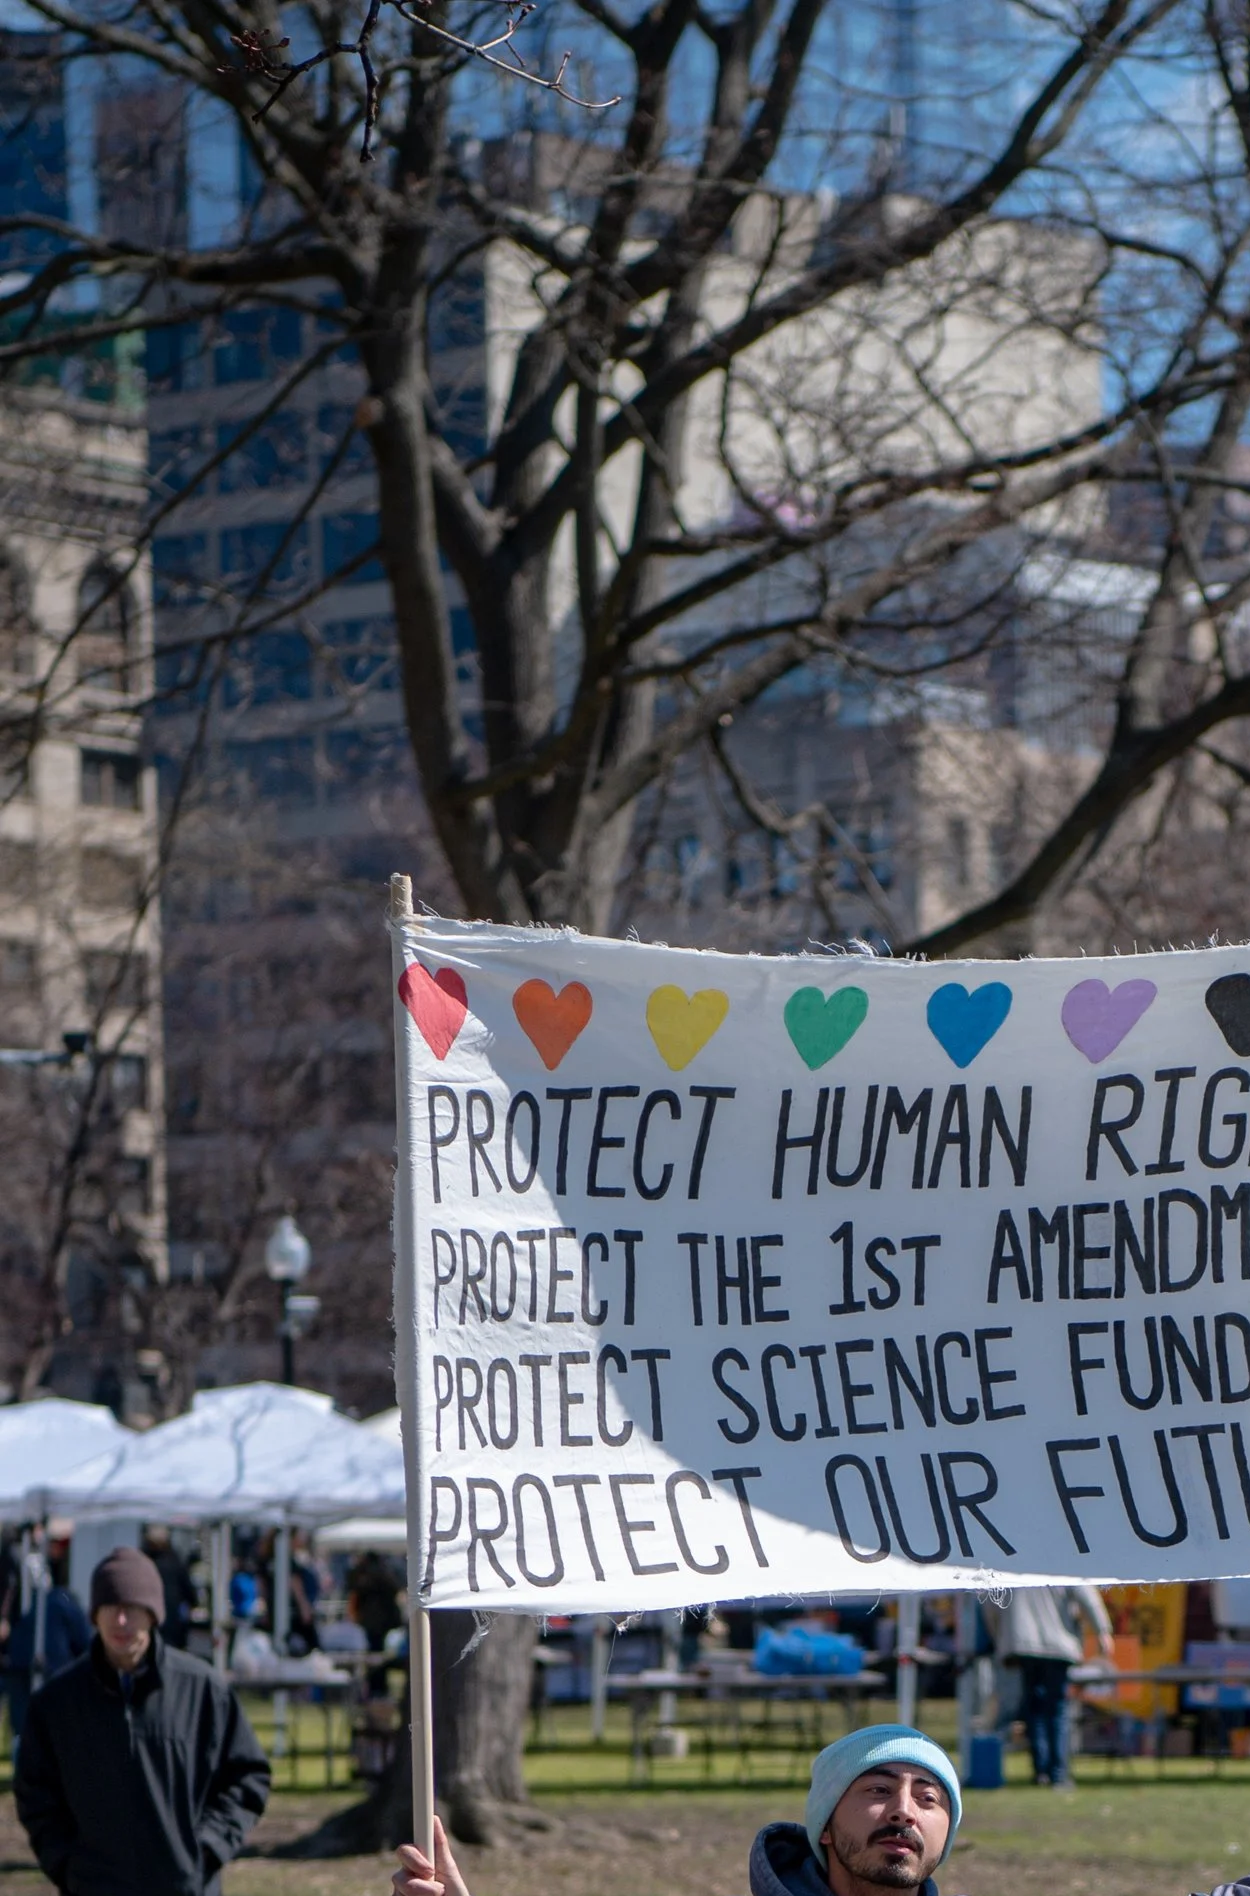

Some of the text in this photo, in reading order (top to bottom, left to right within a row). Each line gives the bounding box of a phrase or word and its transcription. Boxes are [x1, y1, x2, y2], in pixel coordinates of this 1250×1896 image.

[427, 1084, 737, 1203] PROTECT
[772, 1083, 1033, 1200] HUMAN
[432, 1228, 644, 1329] PROTECT
[676, 1233, 790, 1327] THE
[828, 1221, 942, 1315] 1ST
[434, 1347, 671, 1451] PROTECT
[711, 1327, 1026, 1444] SCIENCE
[422, 1467, 769, 1596] PROTECT
[824, 1450, 1017, 1566] OUR
